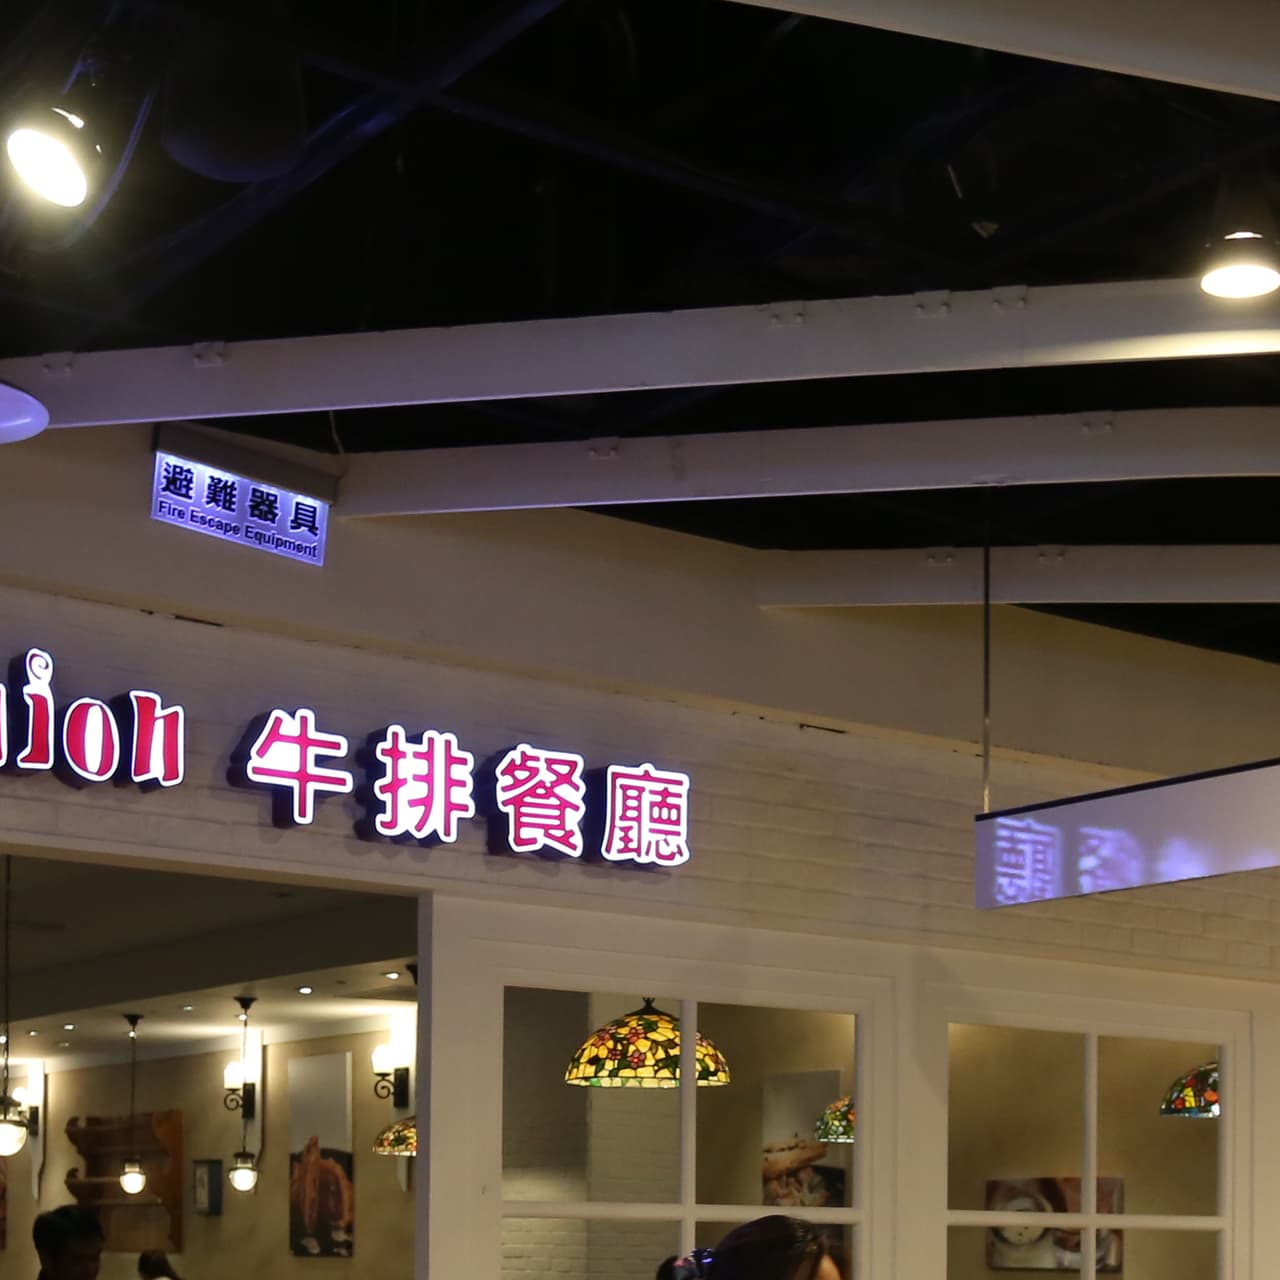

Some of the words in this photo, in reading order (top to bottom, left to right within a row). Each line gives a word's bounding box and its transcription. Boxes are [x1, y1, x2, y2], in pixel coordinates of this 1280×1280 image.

[158, 500, 186, 520] Fire
[190, 509, 240, 536] Escape
[245, 525, 318, 558] Equipment
[161, 462, 319, 536] 避難器具
[246, 707, 690, 866] 牛排餐廳
